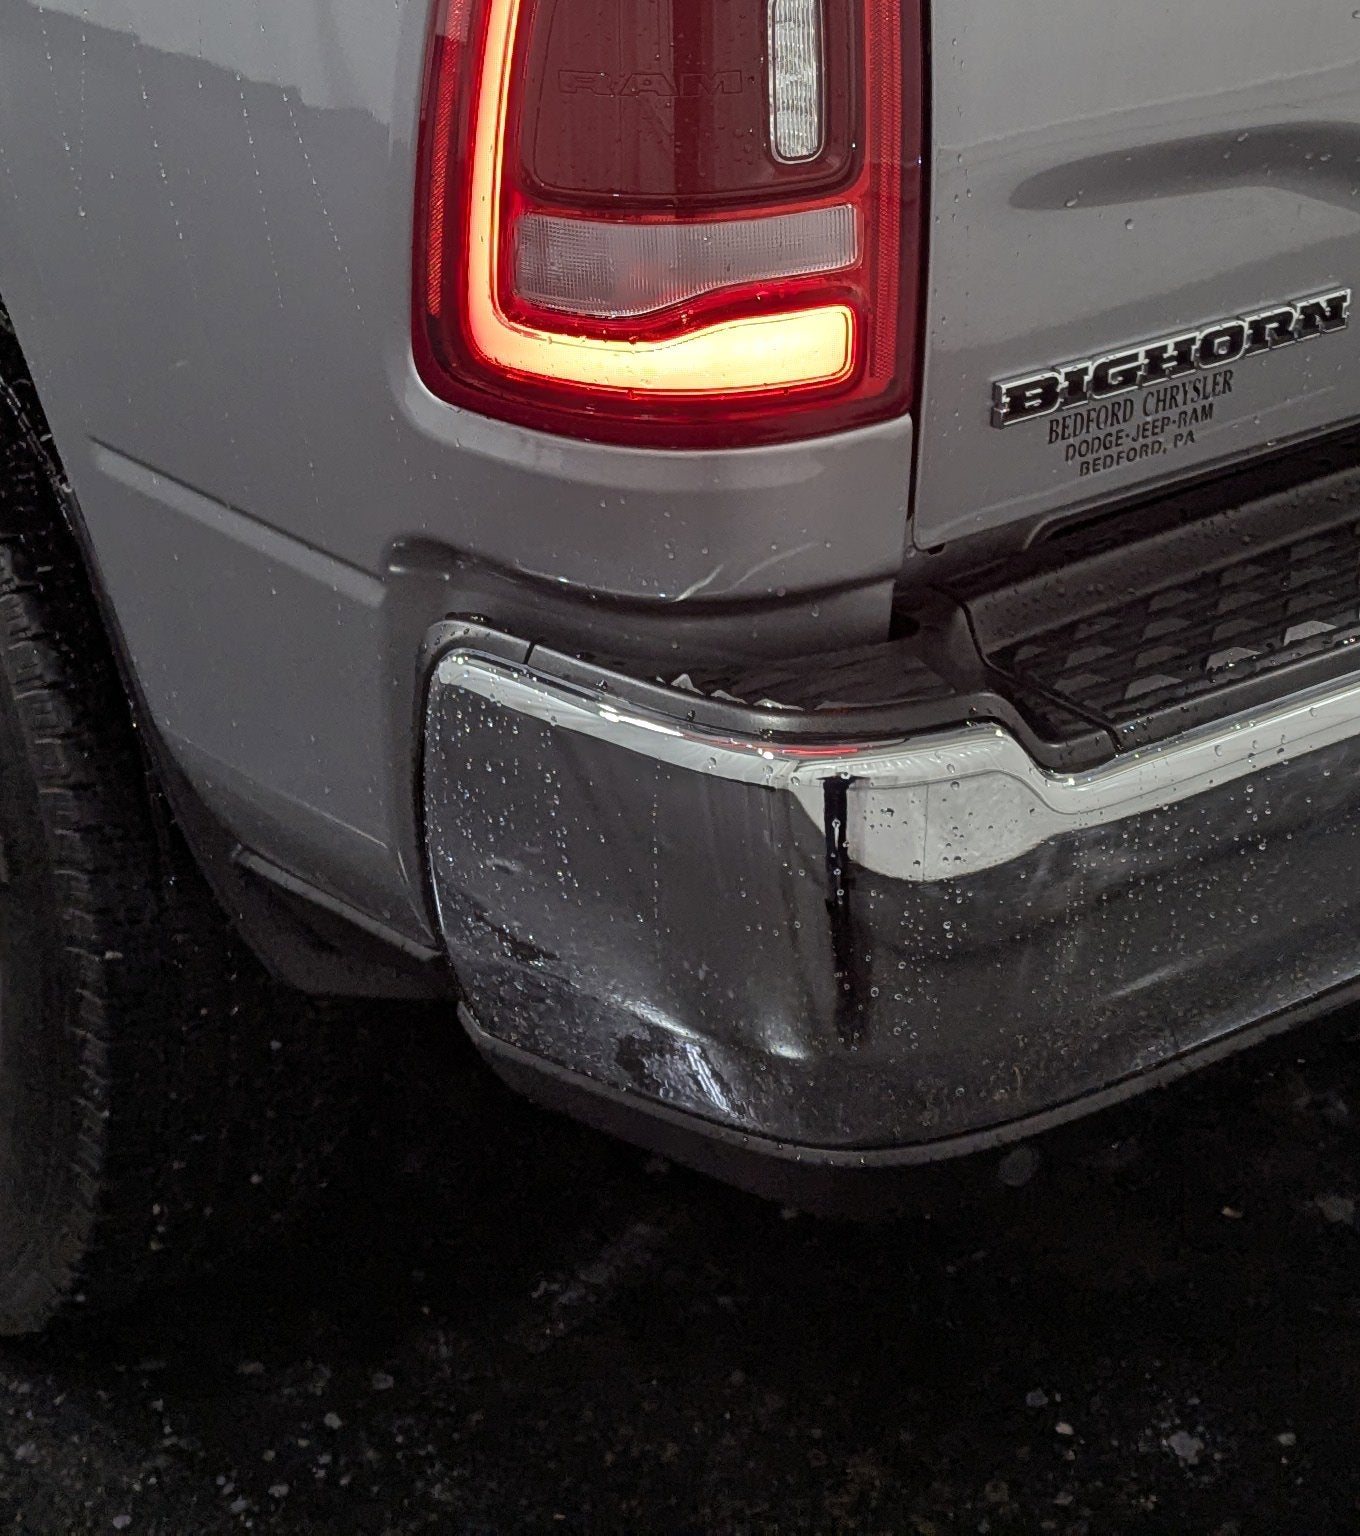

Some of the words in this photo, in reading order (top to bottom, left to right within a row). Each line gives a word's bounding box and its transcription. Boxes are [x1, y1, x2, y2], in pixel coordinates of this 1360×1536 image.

[557, 69, 744, 97] RAM
[1047, 398, 1135, 445] BEDFORD
[1142, 369, 1235, 417] CHRYSLER
[1173, 429, 1196, 449] PA
